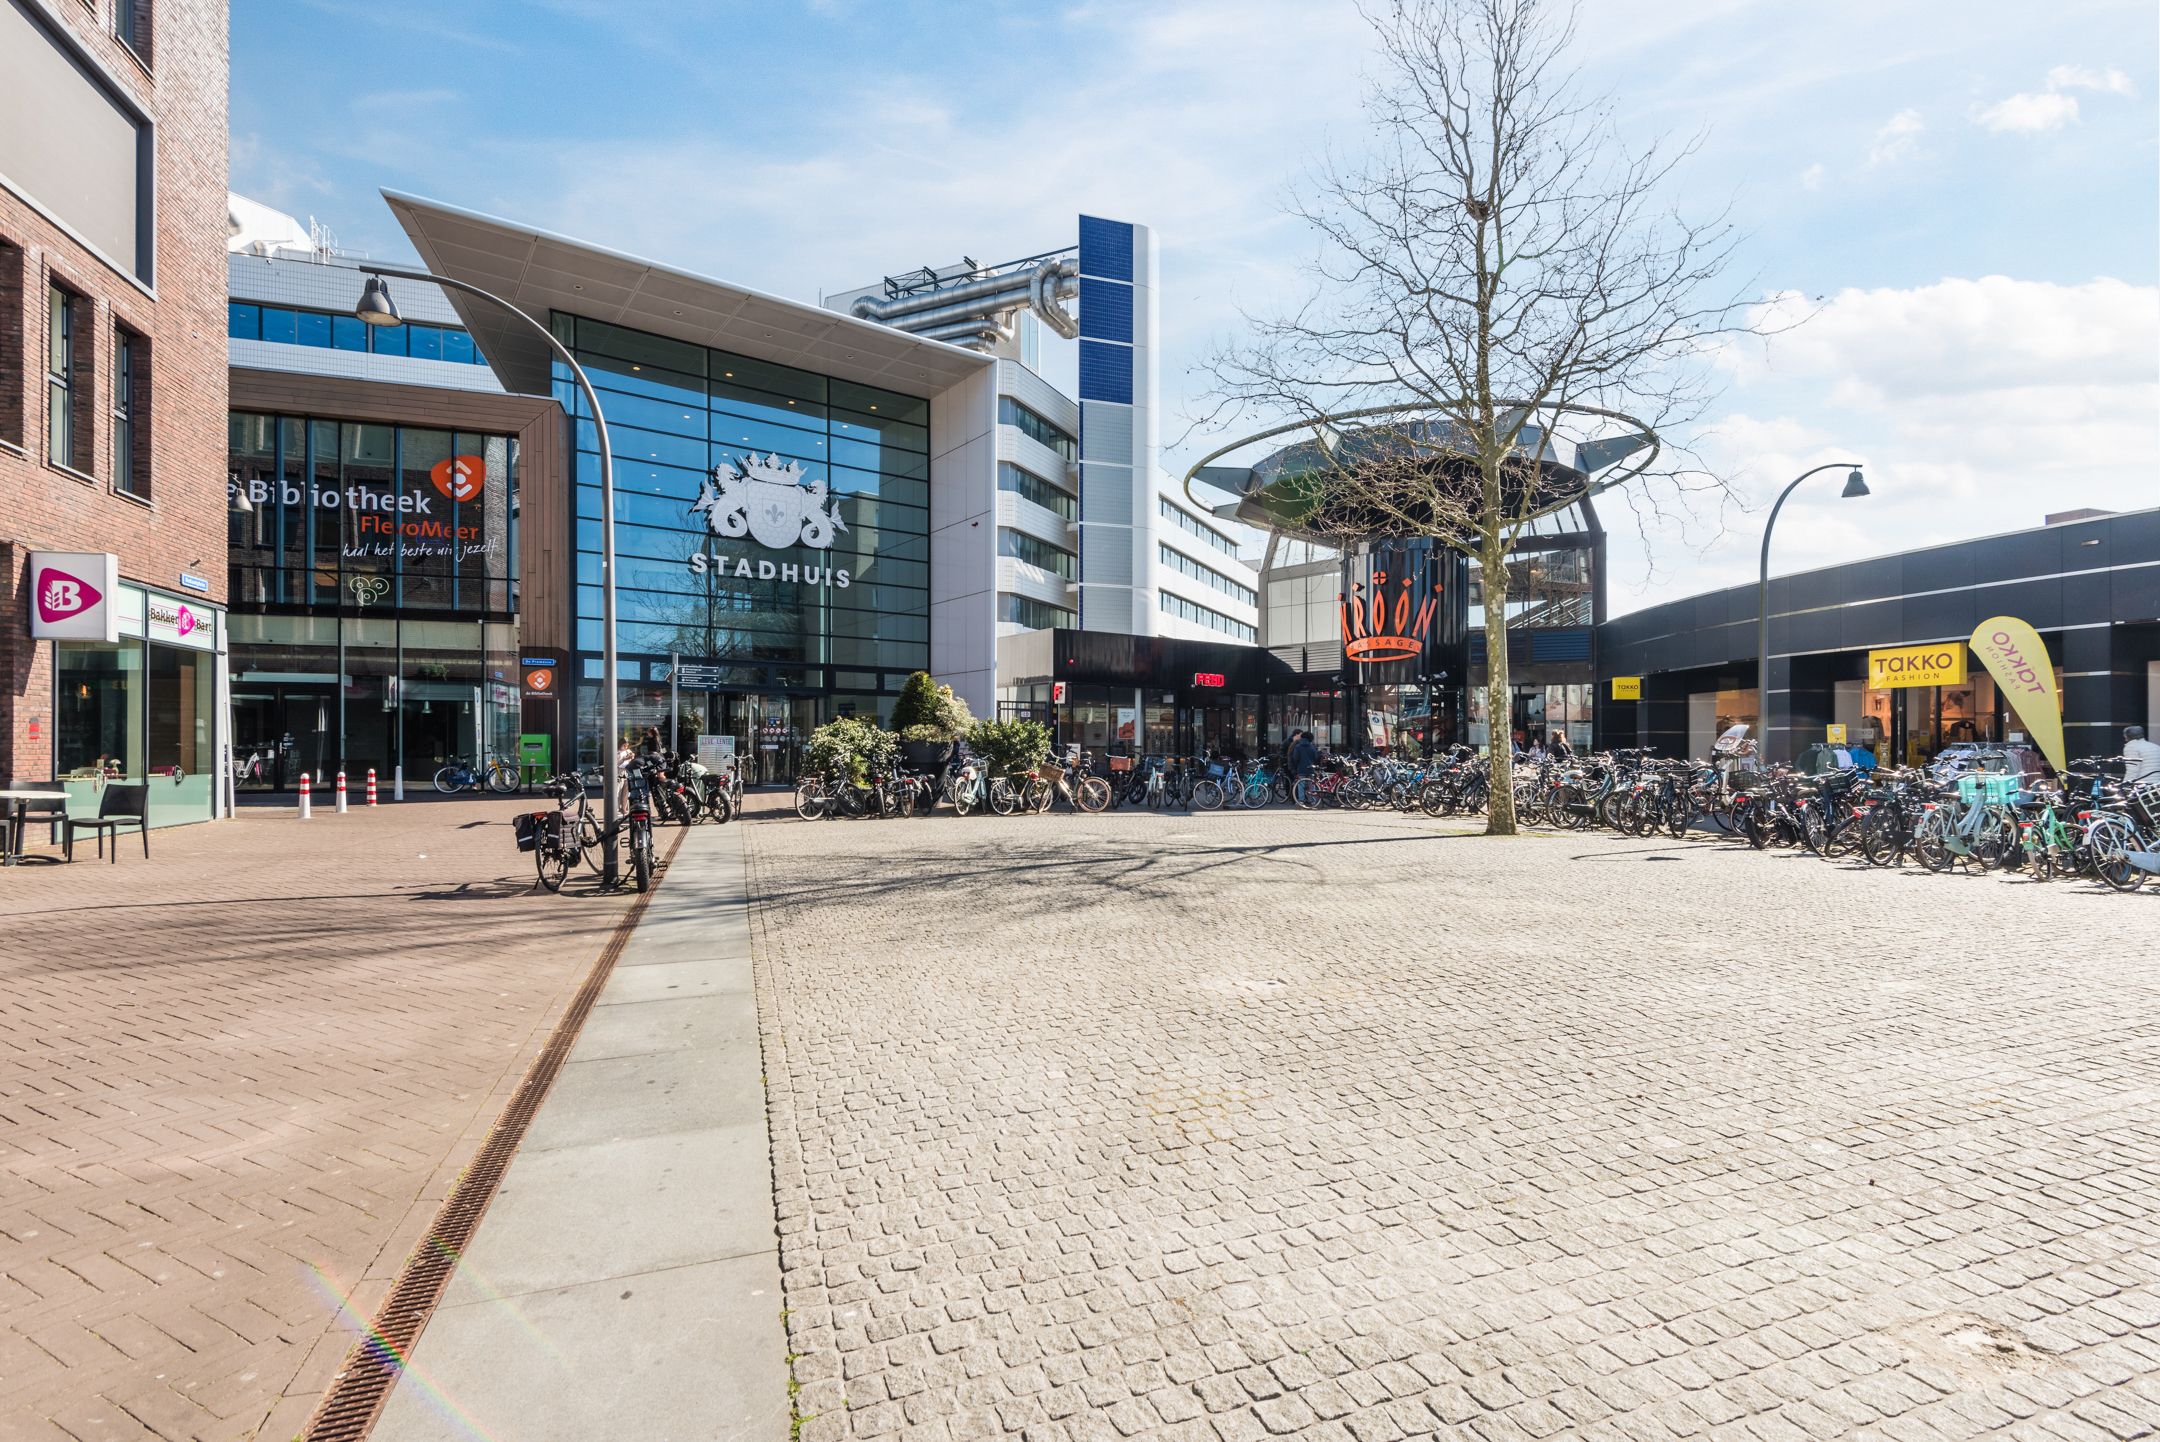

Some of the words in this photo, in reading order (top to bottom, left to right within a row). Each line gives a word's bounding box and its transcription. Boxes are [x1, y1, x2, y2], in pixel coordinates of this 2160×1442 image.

[249, 479, 431, 514] Bibliotheek
[361, 515, 478, 540] FlevoMeer
[342, 543, 368, 557] haal
[374, 542, 394, 556] het
[400, 542, 433, 556] beste
[456, 535, 499, 562] jezelf
[691, 552, 850, 588] STADHUIS
[150, 608, 178, 625] Bakker
[196, 618, 212, 632] Bart
[1339, 588, 1438, 645] KROON
[1195, 672, 1224, 687] FEBO
[1886, 672, 1940, 682] FASHION
